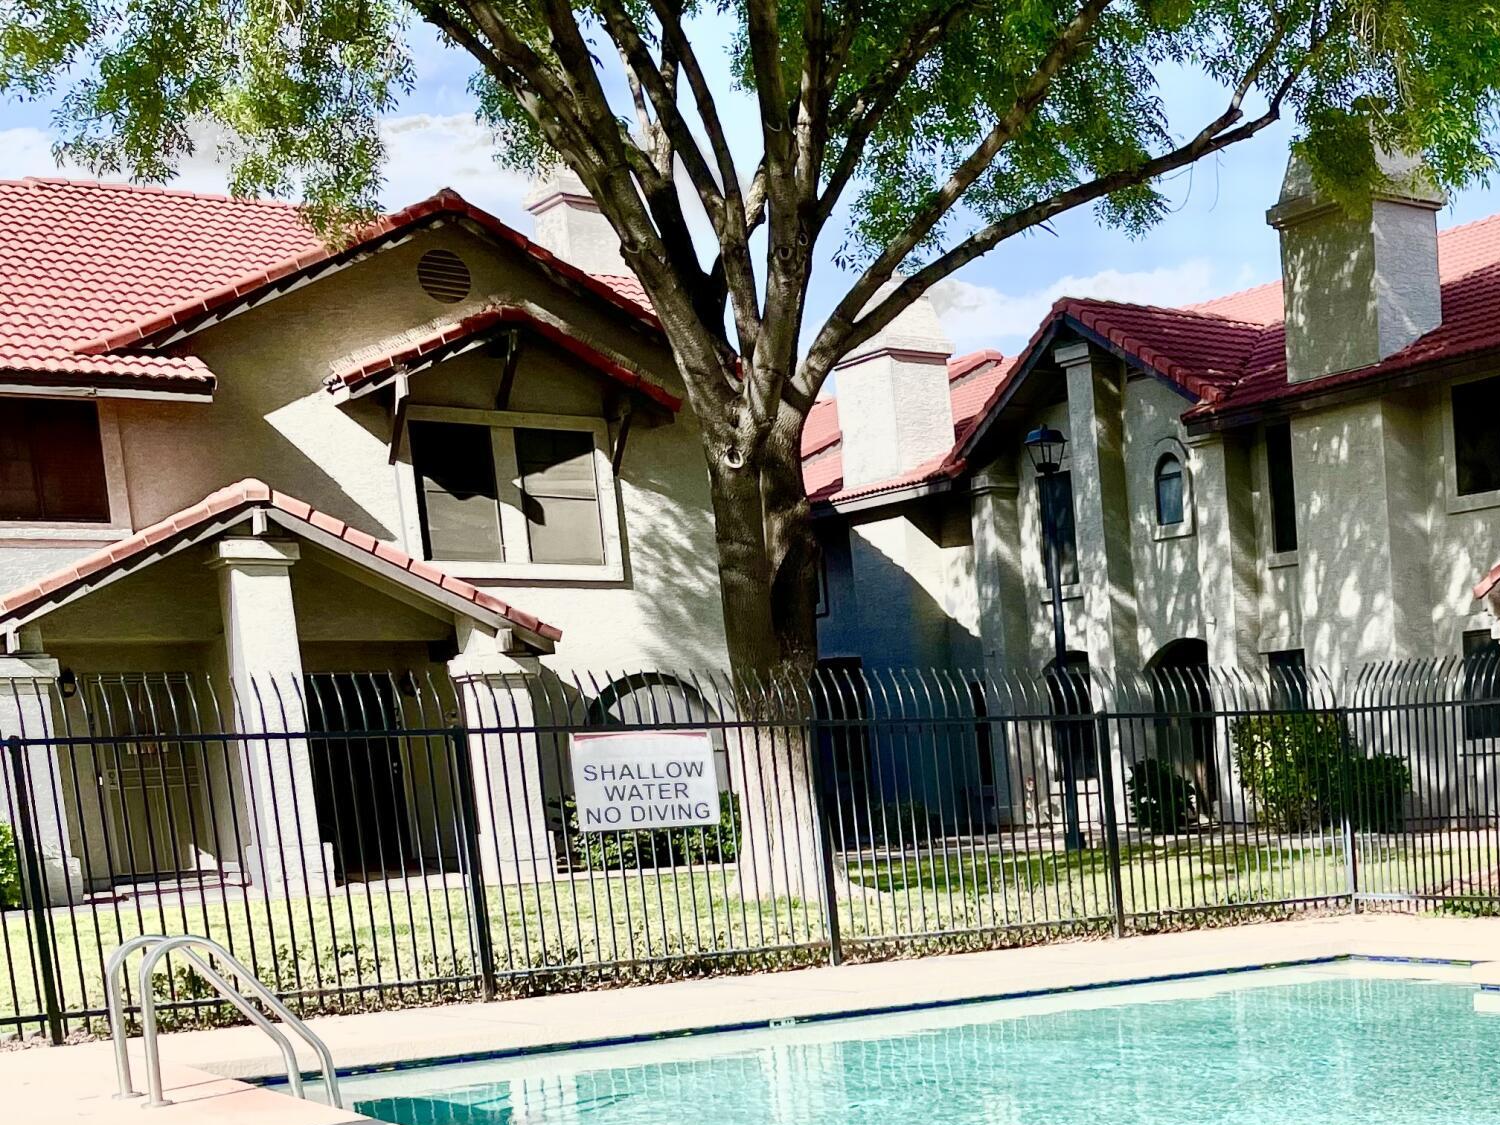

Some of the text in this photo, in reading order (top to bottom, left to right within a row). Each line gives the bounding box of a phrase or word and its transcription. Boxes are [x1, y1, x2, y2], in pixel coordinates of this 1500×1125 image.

[584, 762, 704, 781] SHALLOW
[604, 783, 689, 801] WATER
[586, 802, 711, 824] NO DIVING
